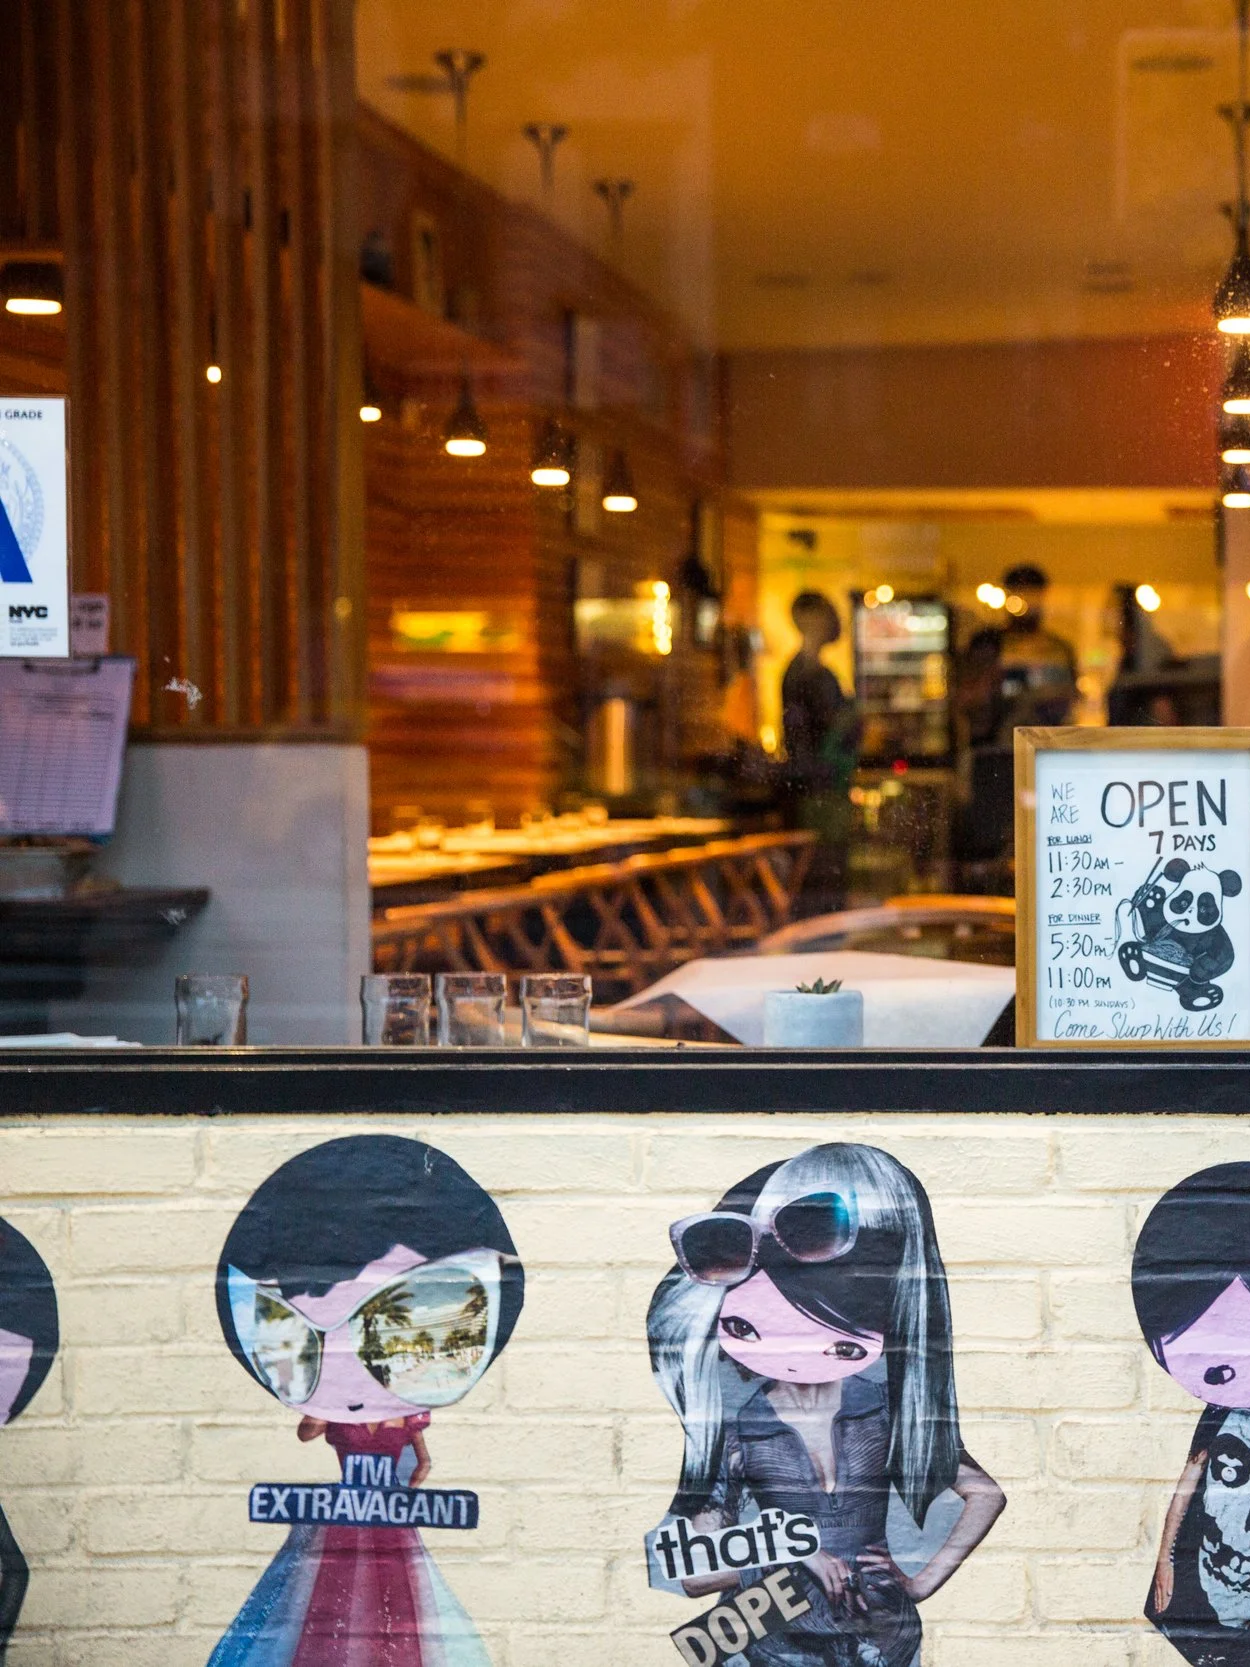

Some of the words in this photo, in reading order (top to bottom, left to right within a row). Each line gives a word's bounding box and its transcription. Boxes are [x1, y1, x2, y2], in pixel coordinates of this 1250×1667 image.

[5, 409, 43, 420] GRADE
[9, 605, 48, 618] NYC
[1051, 782, 1075, 801] WE
[1100, 778, 1228, 828] OPEN
[1050, 804, 1080, 825] ARE
[1047, 835, 1063, 846] FOR
[1066, 834, 1092, 844] LUNCH
[1149, 830, 1164, 854] 7
[1172, 834, 1216, 852] DAYS
[1048, 913, 1063, 924] FOR
[1068, 913, 1101, 922] DINNER
[1078, 998, 1090, 1007] PM
[1054, 1009, 1104, 1038] Come
[1107, 1011, 1151, 1039] Slurp
[1153, 1014, 1193, 1040] With
[345, 1454, 393, 1487] I'M
[251, 1487, 474, 1526] EXTRAVAGANT
[655, 1511, 818, 1579] that's
[671, 1567, 811, 1667] DOPE
